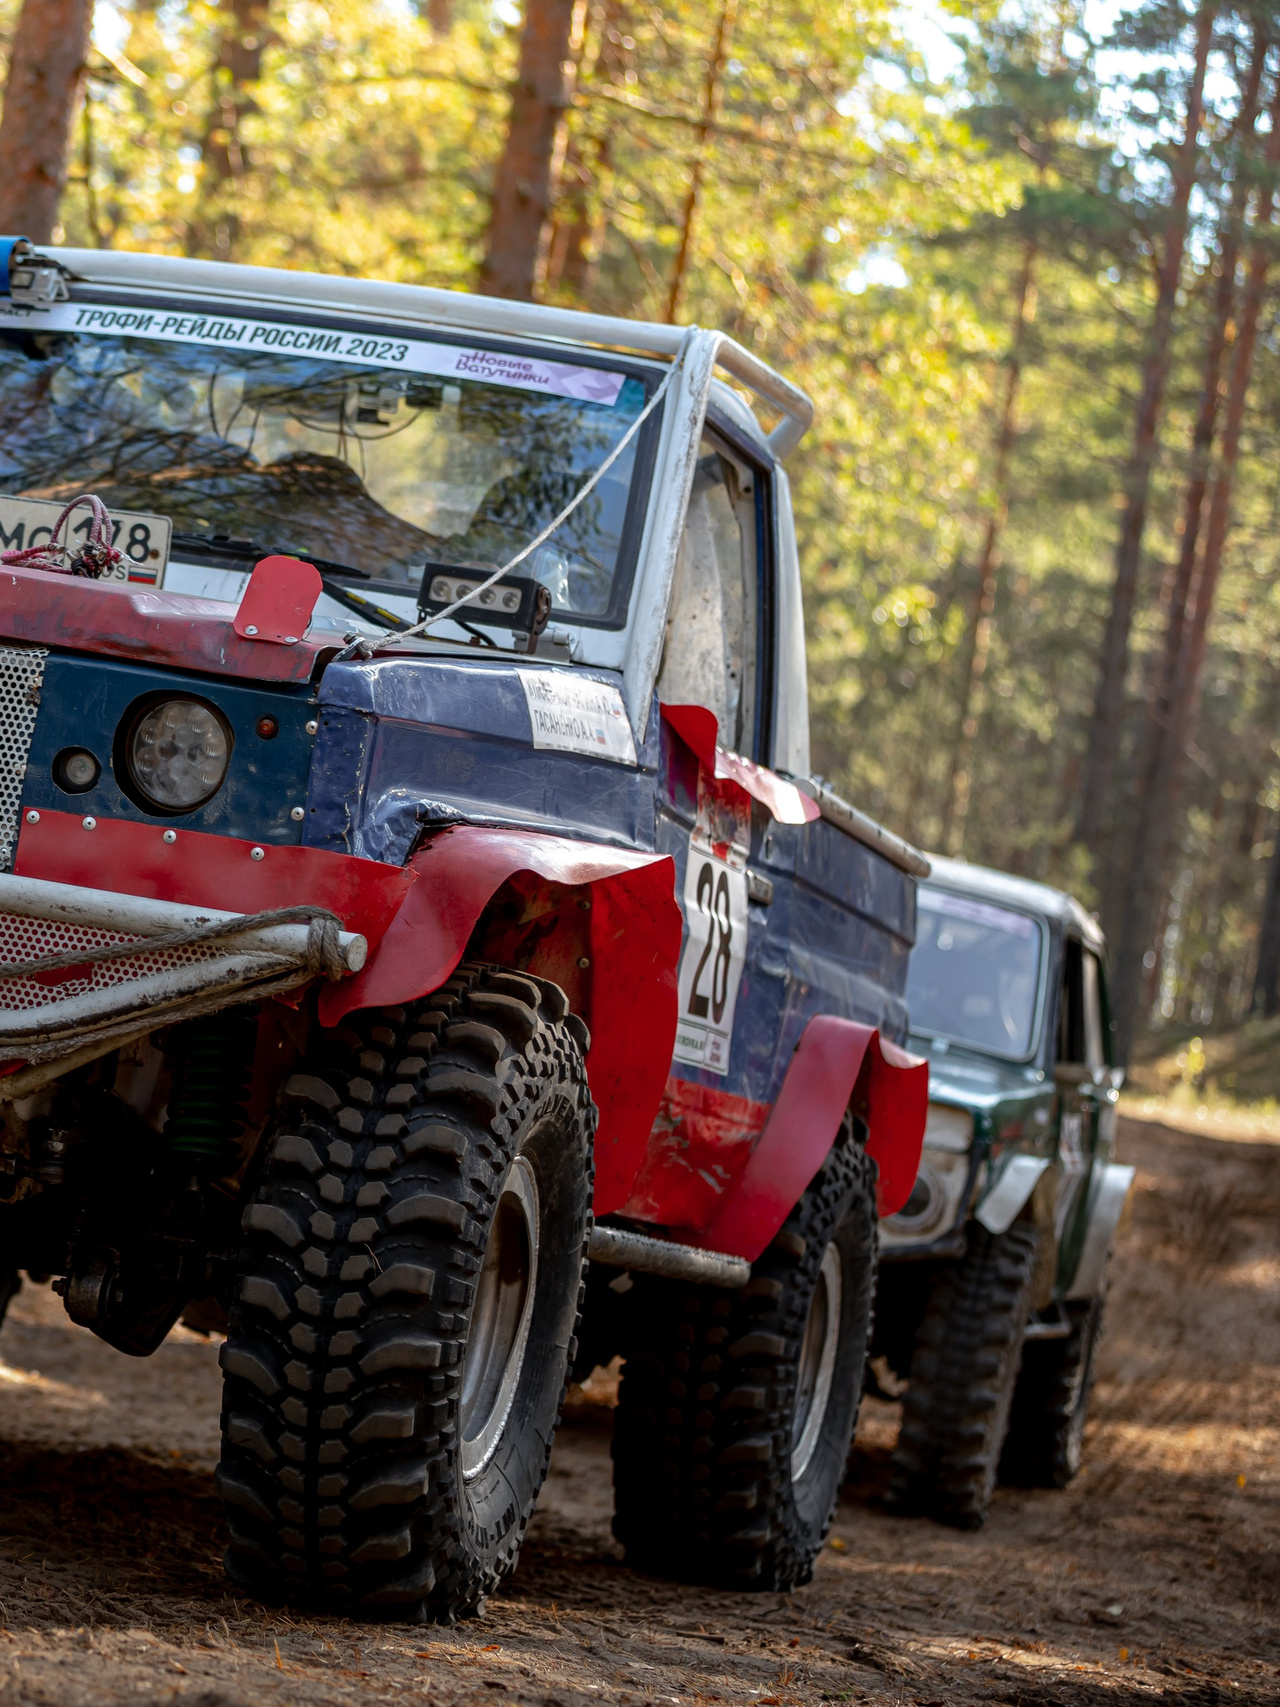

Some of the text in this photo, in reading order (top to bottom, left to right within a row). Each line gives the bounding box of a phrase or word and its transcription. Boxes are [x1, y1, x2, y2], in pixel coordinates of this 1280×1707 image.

[74, 309, 410, 362] ТРОФИ-РЕЙДЫ РОССИИ.2023
[687, 861, 732, 1025] 28
